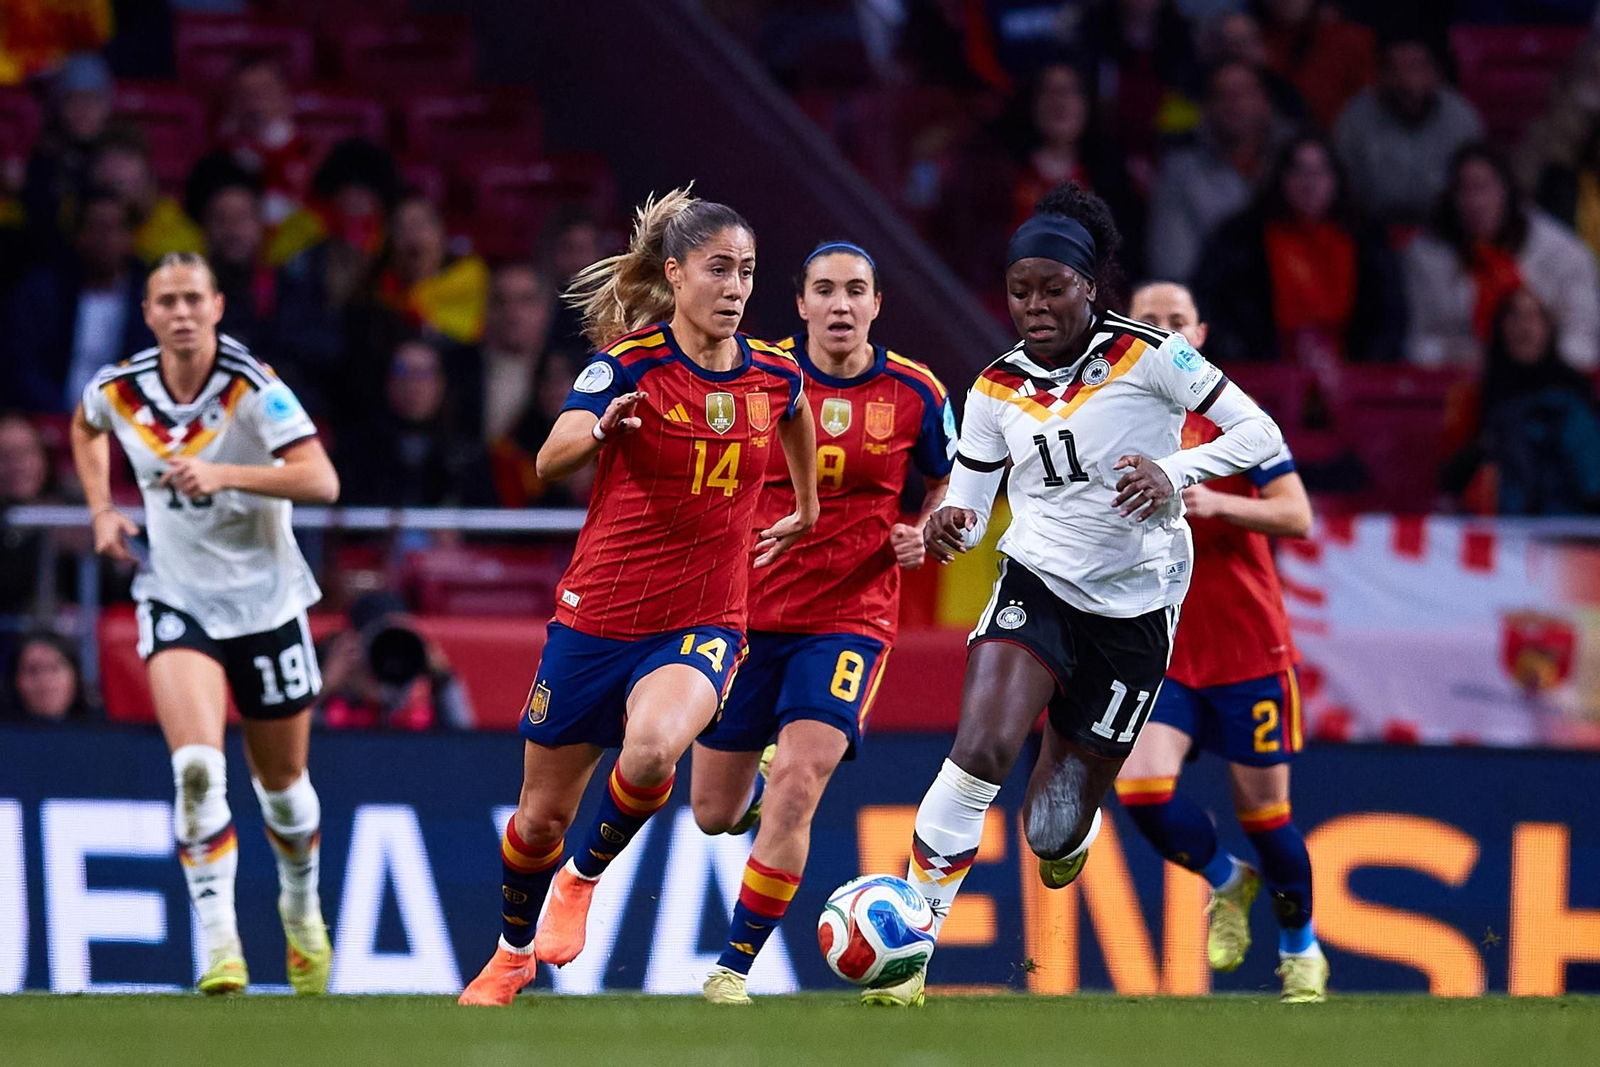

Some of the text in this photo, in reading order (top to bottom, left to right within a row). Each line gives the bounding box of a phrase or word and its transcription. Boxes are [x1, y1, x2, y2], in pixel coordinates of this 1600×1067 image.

[691, 440, 741, 497] 14
[817, 445, 846, 490] 8
[1033, 429, 1090, 487] 11
[253, 643, 310, 706] 19
[680, 635, 728, 673] 14
[830, 650, 865, 702] 8
[1091, 680, 1150, 742] 11
[1252, 700, 1279, 753] 2
